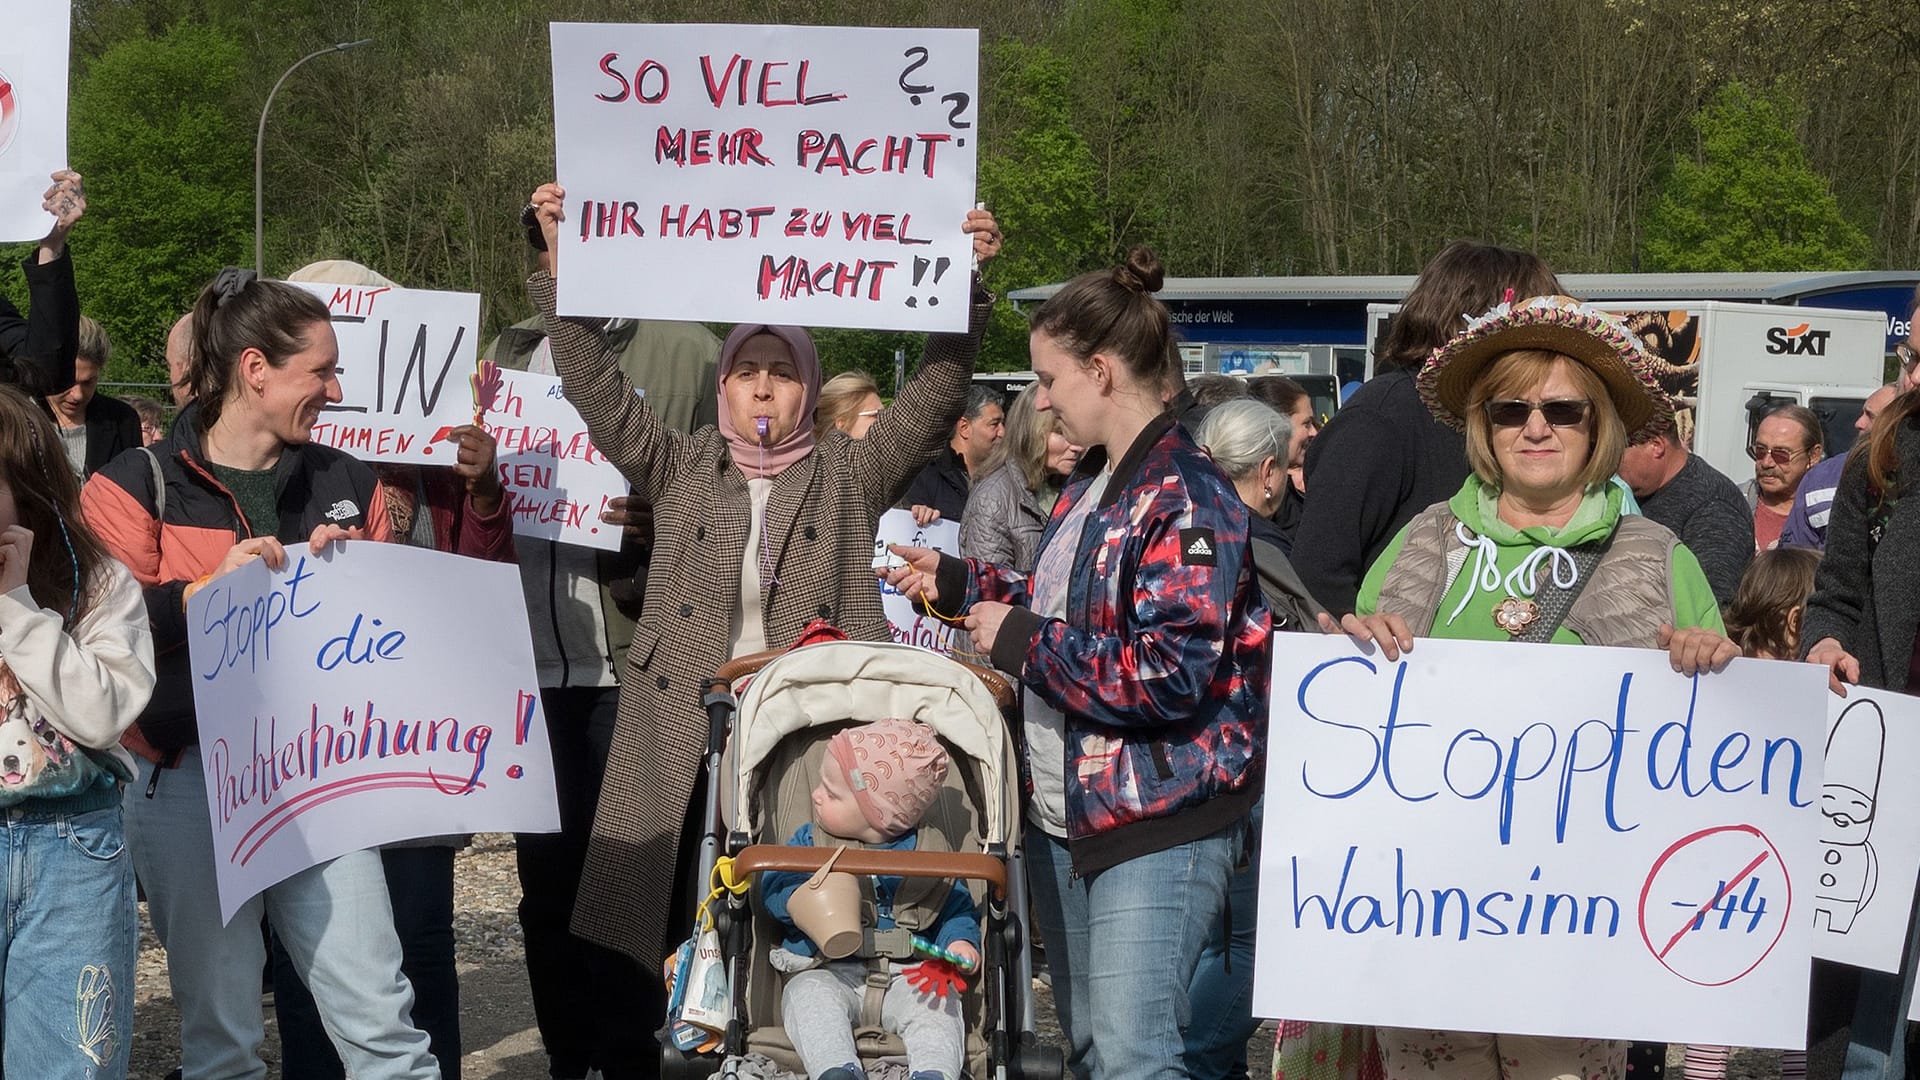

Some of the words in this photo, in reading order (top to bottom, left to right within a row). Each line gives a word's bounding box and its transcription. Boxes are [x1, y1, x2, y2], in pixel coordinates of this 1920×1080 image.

[595, 53, 669, 104] SO
[699, 53, 848, 108] VIEL
[655, 125, 775, 168] MEHR
[797, 129, 952, 178] PACHT
[580, 200, 645, 242] IHR
[660, 204, 775, 241] HABT
[784, 208, 832, 237] ZU
[842, 210, 933, 245] VIEL
[328, 287, 391, 315] MIT
[1194, 310, 1211, 323] der
[1212, 310, 1235, 323] Welt
[309, 423, 415, 455] TIMMEN
[1187, 548, 1213, 556] adidas
[203, 556, 321, 681] Stoppt
[316, 613, 407, 671] die
[1297, 656, 1641, 845] Stoppt
[1648, 671, 1814, 808] den
[1292, 846, 1621, 941] Wahnsinn
